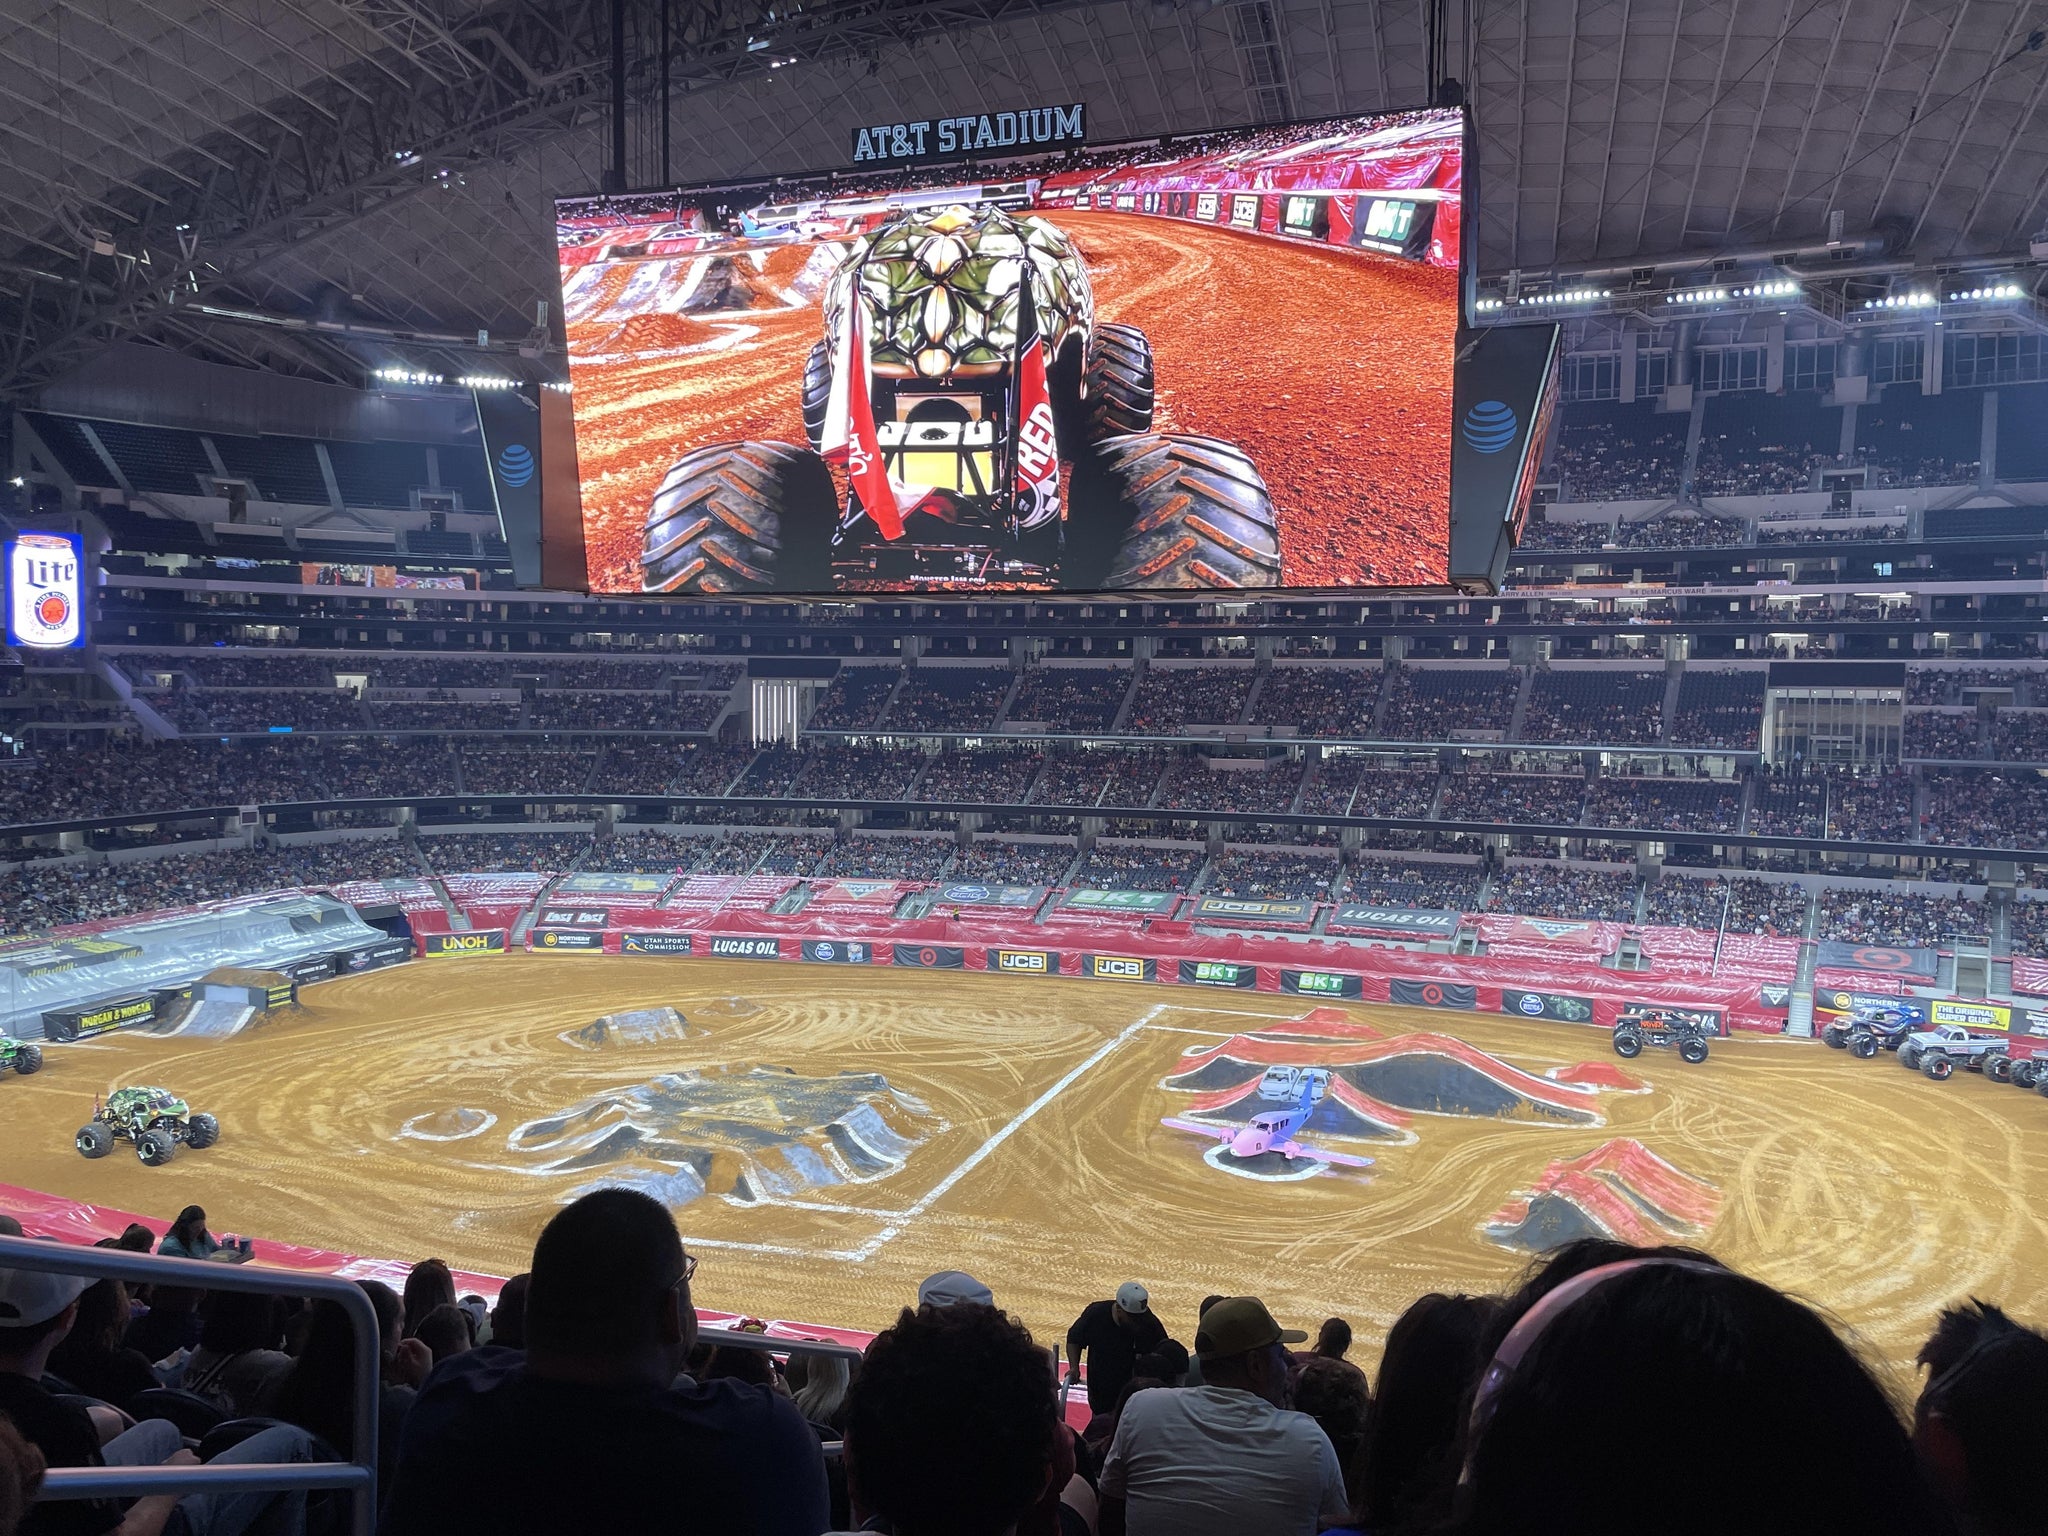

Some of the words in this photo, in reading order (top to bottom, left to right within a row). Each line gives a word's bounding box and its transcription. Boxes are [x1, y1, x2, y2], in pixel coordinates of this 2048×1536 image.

[854, 121, 930, 161] AT&T
[938, 104, 1083, 152] STADIUM
[26, 558, 74, 589] Lite
[1072, 890, 1166, 906] BKT
[1208, 901, 1263, 911] JCB
[1342, 910, 1413, 922] LUCAS
[1416, 916, 1450, 925] OIL
[442, 935, 488, 950] UNOH
[713, 940, 753, 954] LUCAS
[756, 942, 777, 955] OIL
[1003, 955, 1042, 968] JCB
[1098, 960, 1139, 975] JCB
[1197, 964, 1238, 980] BKT
[1299, 973, 1343, 991] BKT
[1854, 997, 1900, 1007] NORTHERN
[81, 1011, 112, 1028] MORGAN
[114, 1010, 120, 1020] &
[121, 1002, 151, 1018] MORGAN
[1936, 1013, 1966, 1023] SUPER
[1968, 1015, 1991, 1024] GLUE
[1937, 1005, 1954, 1013] THE
[1956, 1007, 1995, 1018] ORIGINAL
